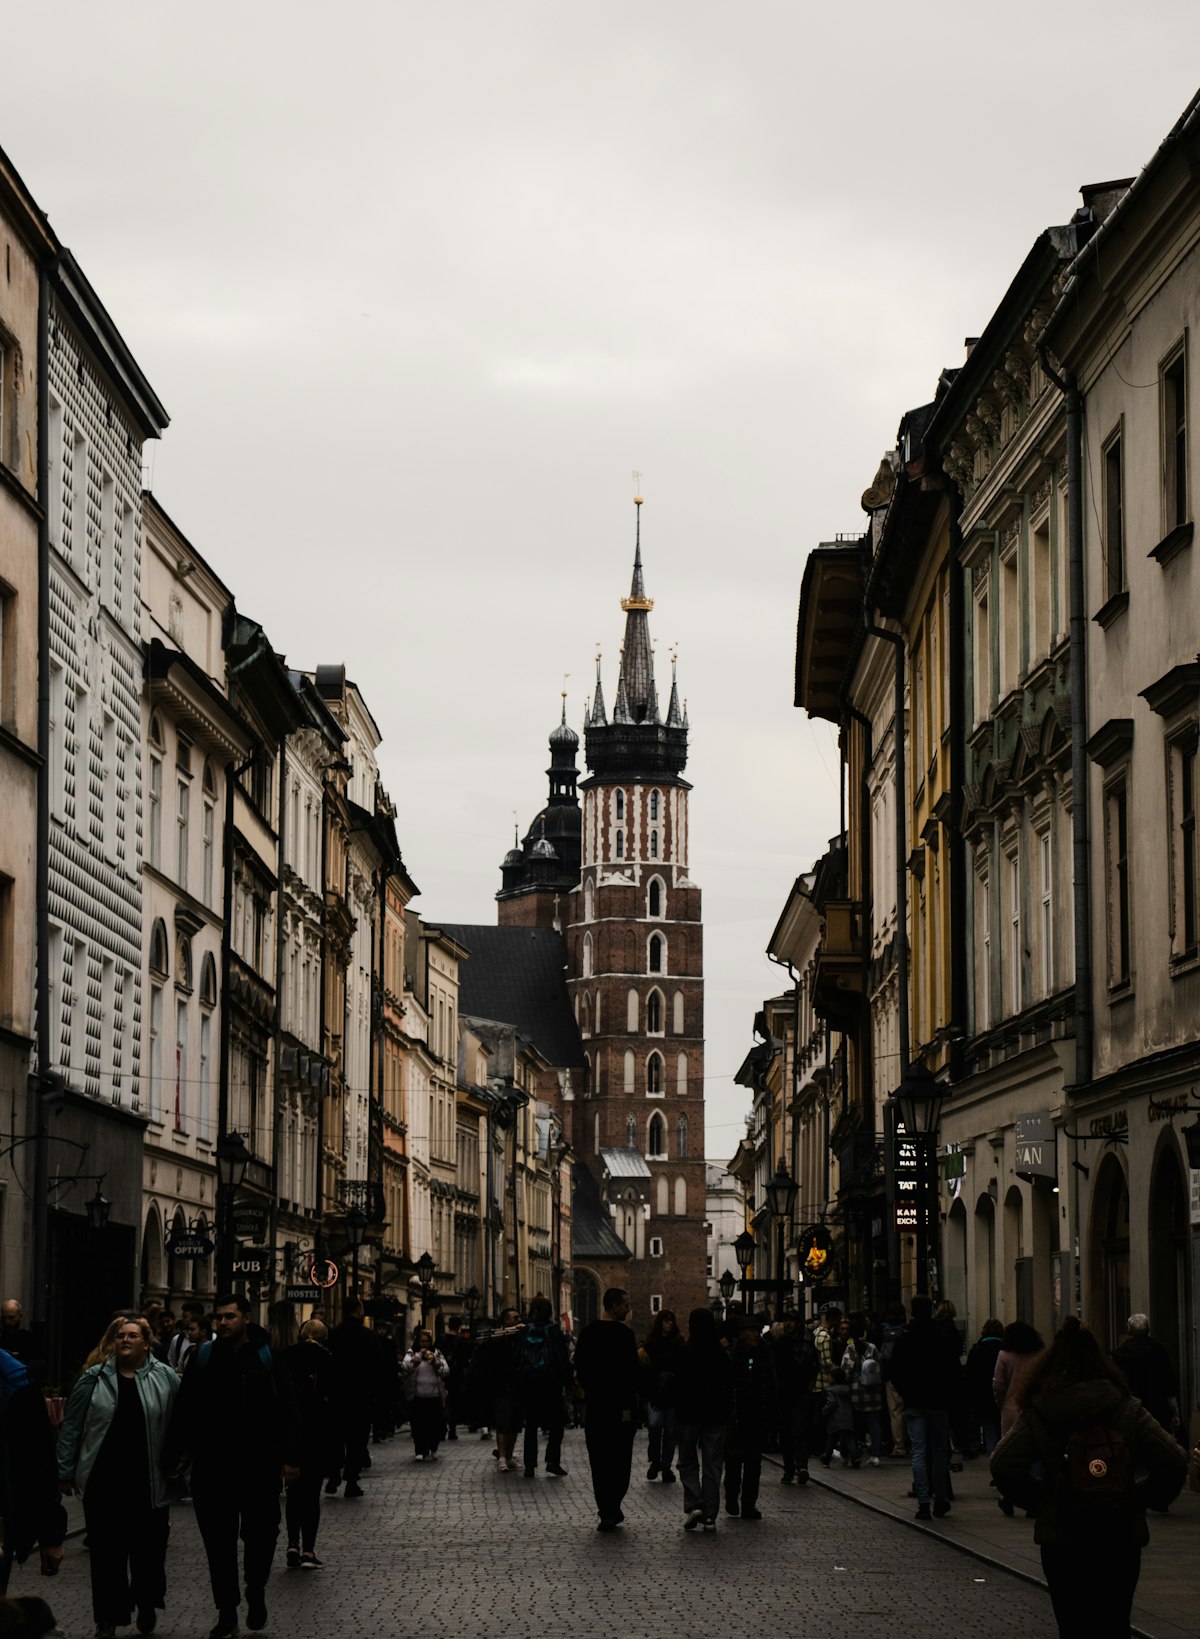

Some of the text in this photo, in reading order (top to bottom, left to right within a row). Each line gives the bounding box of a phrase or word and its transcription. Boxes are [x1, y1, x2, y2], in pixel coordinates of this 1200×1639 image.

[174, 1246, 204, 1255] OPTYK
[232, 1260, 261, 1272] PUB
[287, 1289, 320, 1298] HOSTEL
